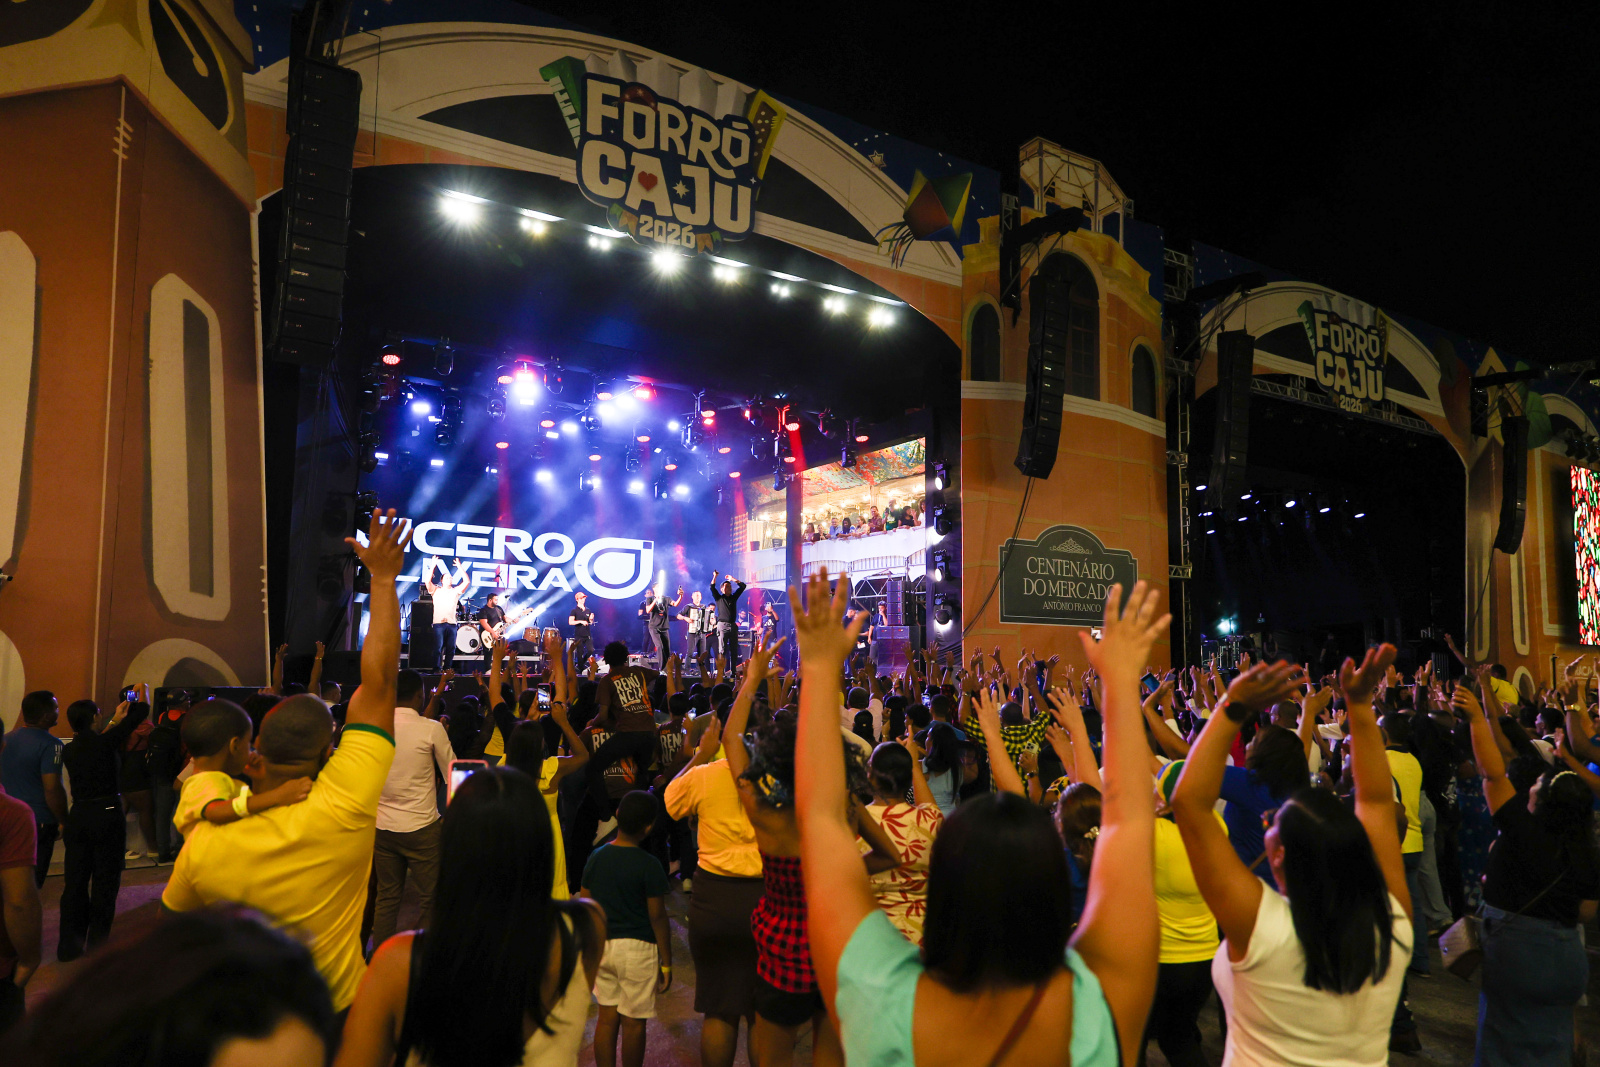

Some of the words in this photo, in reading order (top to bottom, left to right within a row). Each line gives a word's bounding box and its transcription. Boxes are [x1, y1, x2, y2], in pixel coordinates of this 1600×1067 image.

[586, 78, 751, 180] FORRÓ
[581, 140, 752, 234] CAJU
[638, 214, 697, 249] 2026
[1314, 312, 1381, 367] FORRÓ
[1316, 350, 1384, 402] CAJU
[1339, 394, 1363, 414] 2026
[1026, 556, 1115, 581] CENTENÁRIO
[1023, 578, 1047, 597] DO
[1042, 600, 1074, 611] ANTÔNIO
[1074, 601, 1102, 613] FRANCO
